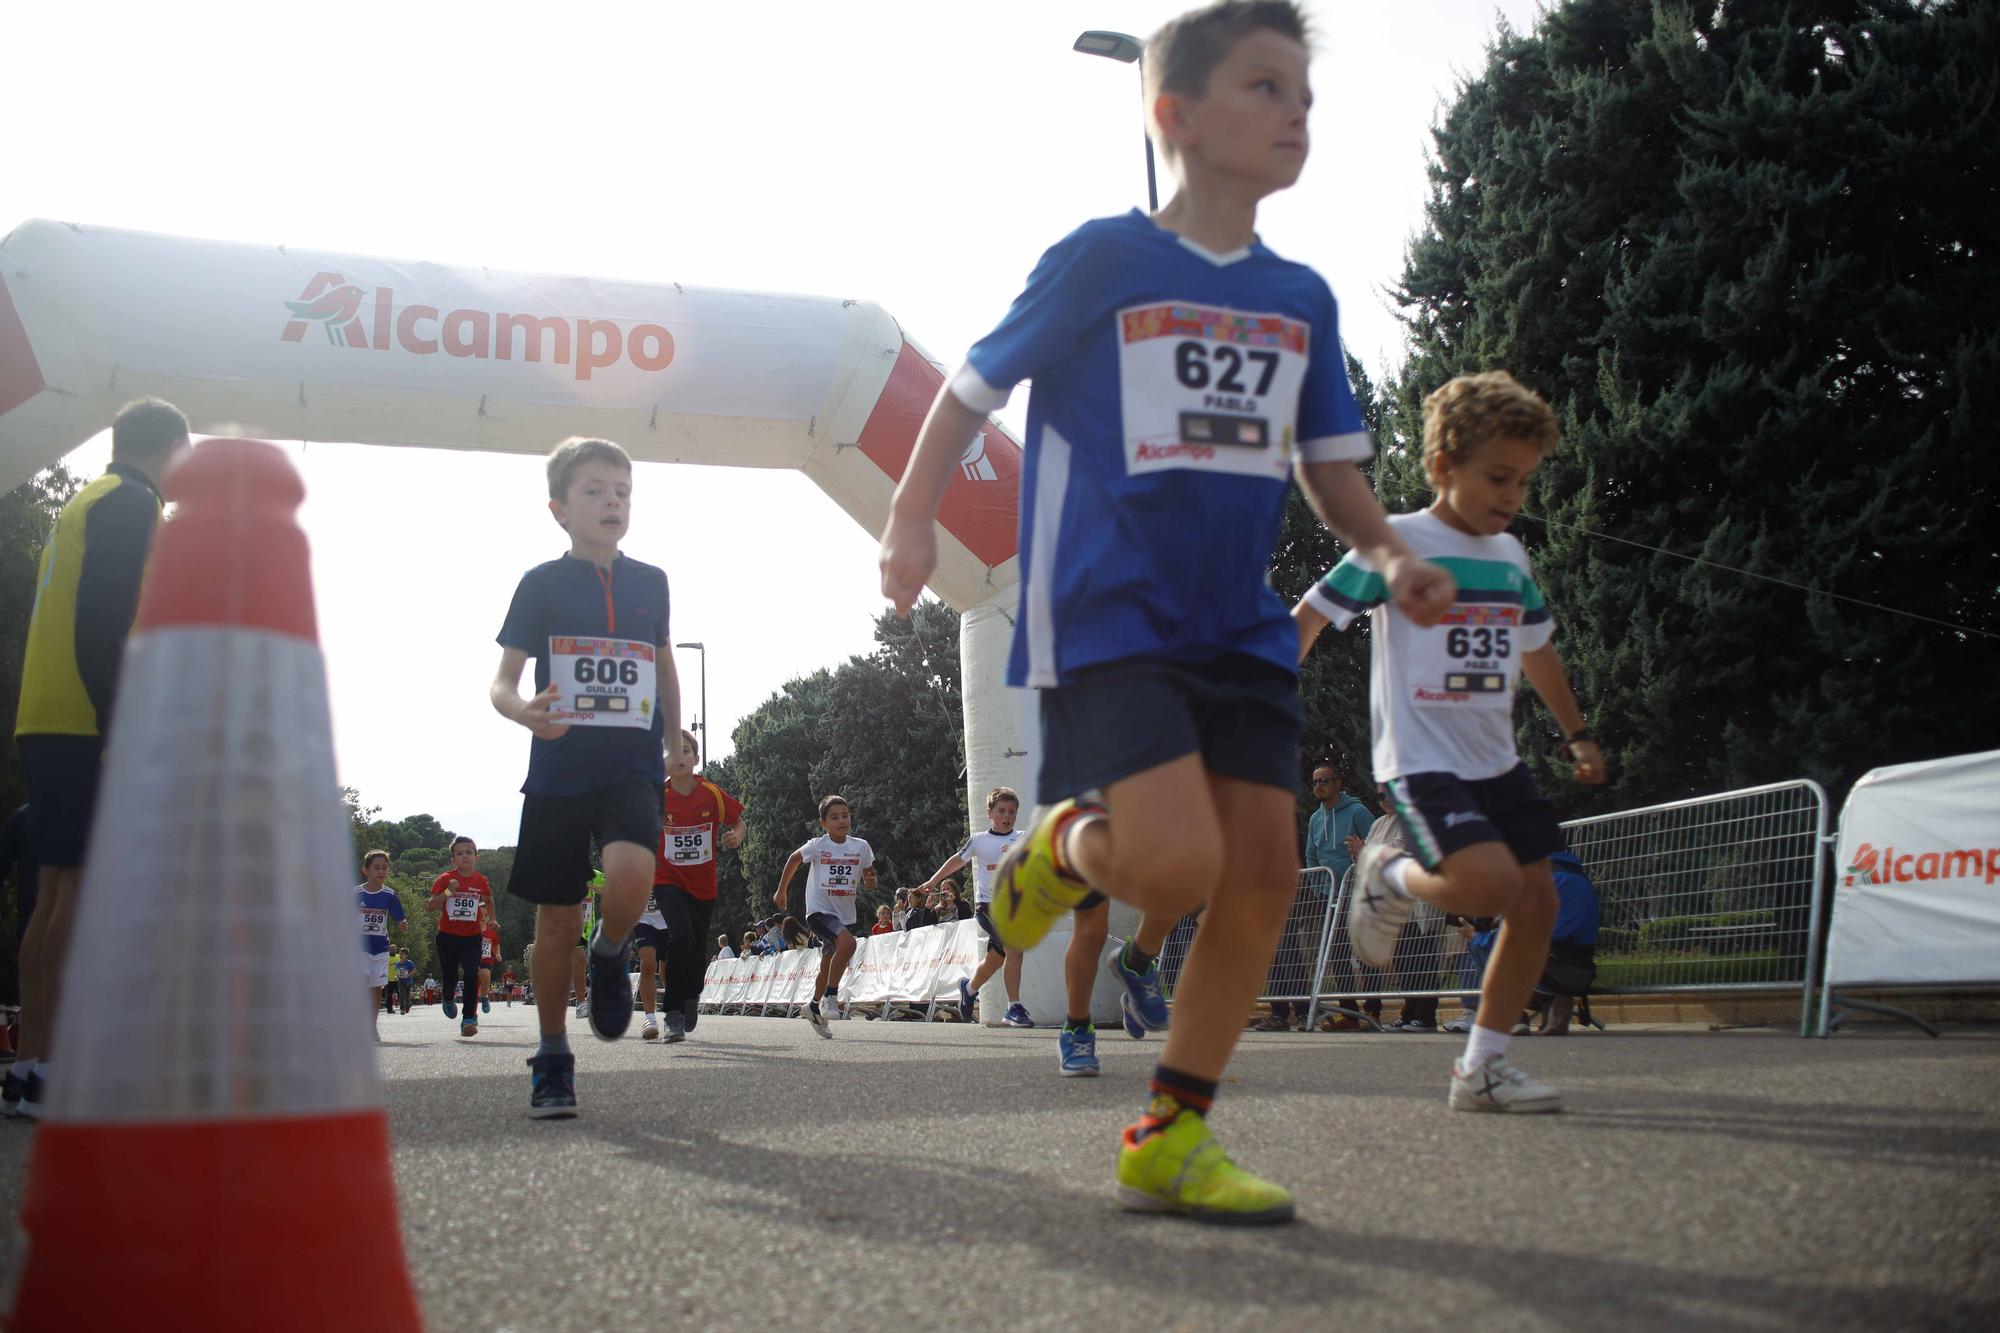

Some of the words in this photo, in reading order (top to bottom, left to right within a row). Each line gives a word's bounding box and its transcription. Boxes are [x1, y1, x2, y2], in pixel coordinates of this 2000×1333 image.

[281, 272, 675, 381] Alcampo
[1175, 341, 1280, 396] 627
[1203, 395, 1258, 413] PABLO
[1447, 628, 1510, 658] 635
[574, 657, 638, 685] 606
[1464, 660, 1499, 669] PABLO
[585, 685, 628, 695] GUILLEN
[674, 835, 703, 848] 556
[829, 865, 852, 876] 582
[454, 898, 475, 908] 560
[364, 914, 384, 924] 569
